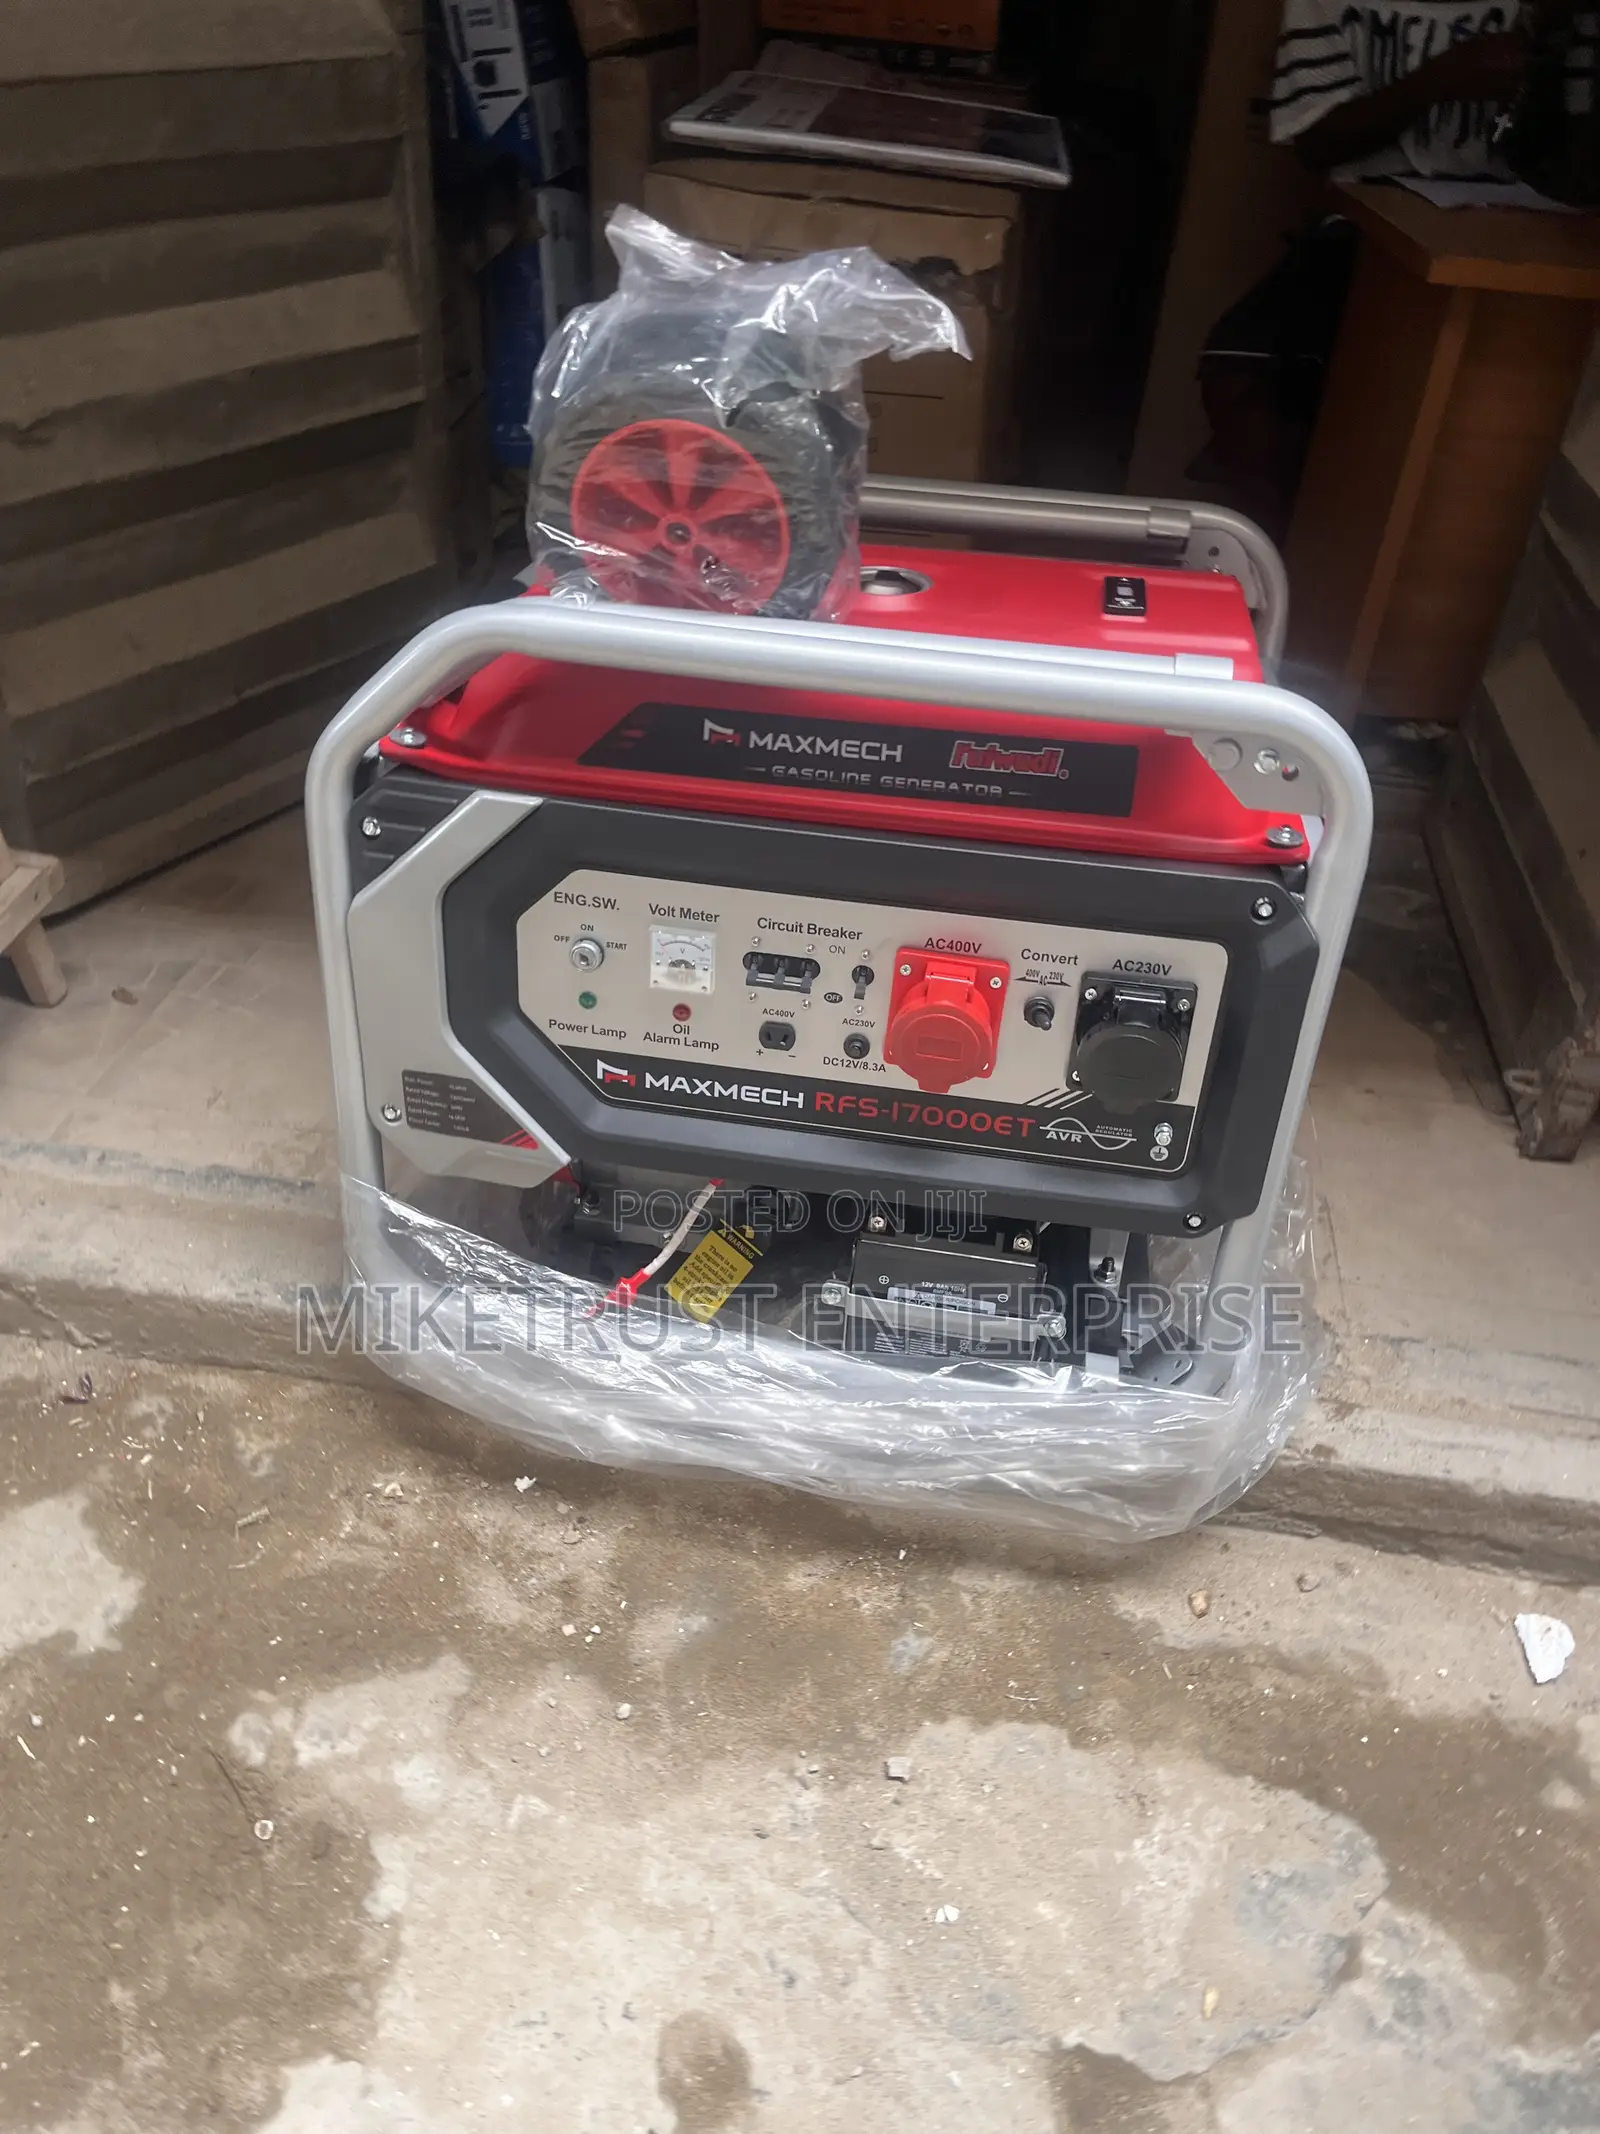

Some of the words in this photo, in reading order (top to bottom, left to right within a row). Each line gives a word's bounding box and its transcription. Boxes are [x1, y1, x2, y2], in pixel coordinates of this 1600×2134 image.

[749, 730, 903, 763] MAXMECH
[772, 765, 872, 786] GASOLINE
[880, 775, 1003, 798] GENERATOR
[554, 891, 620, 911] ENG.SW.
[649, 903, 676, 918] Volt
[679, 907, 720, 923] Meter
[580, 924, 594, 932] ON
[757, 917, 803, 934] Circuit
[807, 923, 863, 940] Breaker
[553, 935, 570, 943] OFF
[606, 941, 628, 950] START
[924, 937, 982, 954] AC400V
[829, 945, 846, 955] ON
[1021, 948, 1079, 966] Convert
[1112, 958, 1172, 976] AC230V
[825, 994, 842, 1002] OFF
[762, 1007, 795, 1018] AC400V
[548, 1019, 588, 1034] Power
[591, 1024, 627, 1040] Lamp
[672, 1023, 690, 1035] Oil
[842, 1017, 876, 1029] AC230V
[643, 1031, 680, 1046] Alarm
[684, 1036, 720, 1052] Lamp
[823, 1056, 887, 1073] DC12V/8.3A
[645, 1072, 804, 1109] MAXMECH
[815, 1091, 1036, 1138] RFS-17000ET
[1045, 1130, 1082, 1143] AVR
[727, 1234, 755, 1259] WARNING
